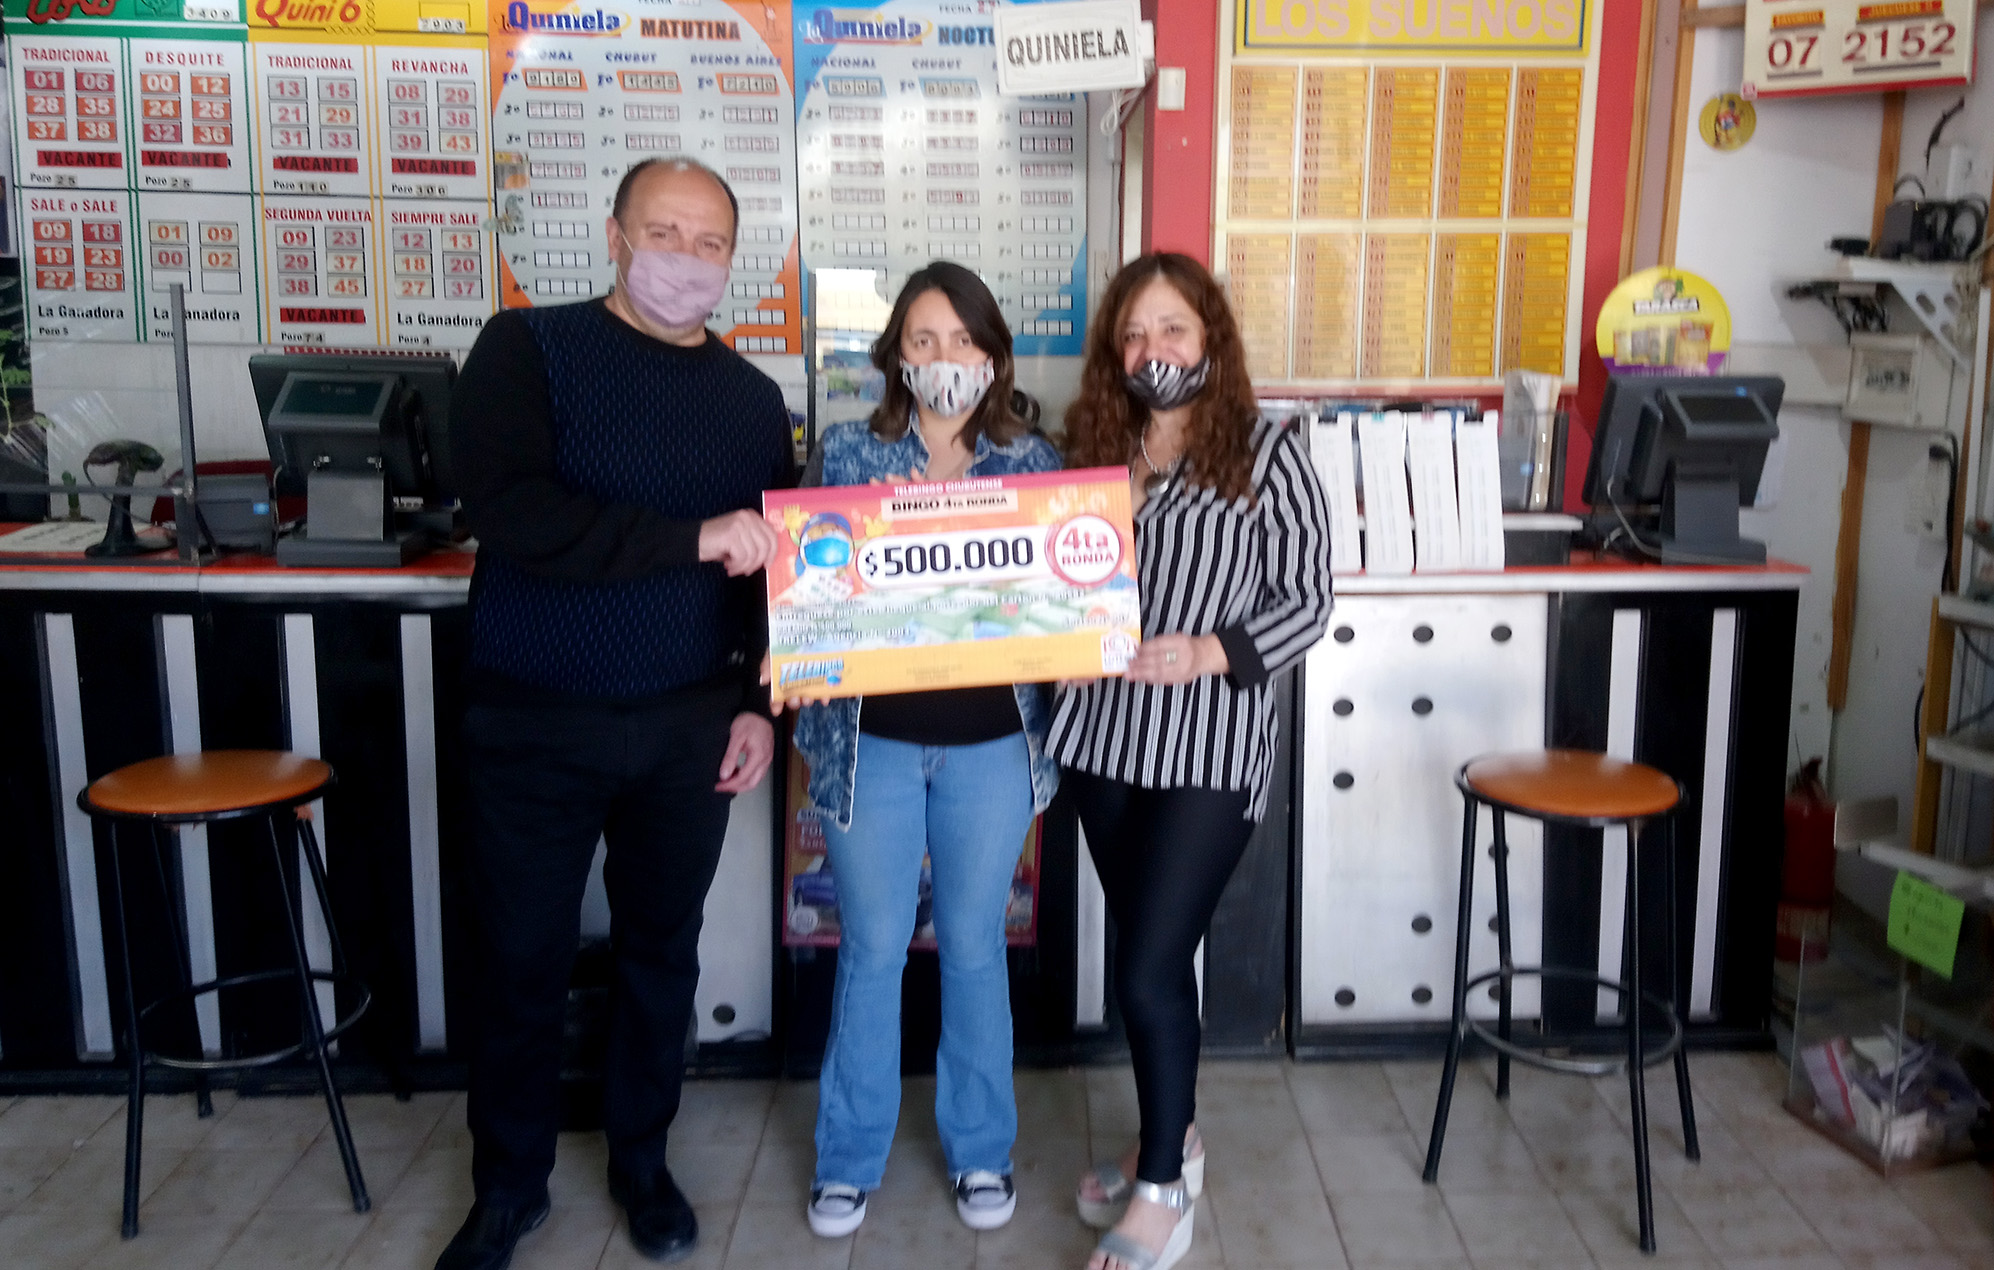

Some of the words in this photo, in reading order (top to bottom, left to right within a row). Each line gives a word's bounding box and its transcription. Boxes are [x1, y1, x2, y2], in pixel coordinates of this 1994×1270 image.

[255, 0, 336, 27] Quini
[339, 0, 361, 23] 6
[1255, 0, 1350, 38] LOS
[640, 18, 741, 40] MATUTINA
[1007, 27, 1130, 68] QUINIELA
[1768, 35, 1818, 67] 07
[1842, 23, 1955, 63] 2152
[22, 47, 111, 63] TRADICIONAL
[146, 52, 225, 66] DESQUITE
[268, 56, 353, 70] TRADICIONAL
[392, 60, 469, 74] REVANCHA
[33, 72, 58, 88] 01
[82, 73, 109, 90] 06
[146, 75, 173, 91] 00
[198, 78, 224, 93] 12
[276, 81, 300, 97] 13
[326, 82, 350, 98] 15
[395, 84, 421, 99] 08
[444, 87, 470, 103] 29
[33, 97, 60, 113] 28
[84, 97, 110, 114] 35
[149, 100, 175, 116] 24
[199, 102, 225, 118] 25
[278, 107, 301, 122] 21
[326, 109, 351, 123] 29
[398, 111, 421, 126] 31
[446, 112, 471, 127] 38
[34, 121, 60, 138] 37
[84, 121, 111, 138] 38
[149, 125, 175, 140] 32
[199, 127, 226, 143] 36
[280, 131, 302, 146] 31
[328, 134, 353, 149] 33
[397, 135, 422, 151] 39
[446, 135, 472, 151] 43
[43, 152, 117, 166] VACANTE
[149, 153, 221, 167] VACANTE
[279, 157, 351, 171] VACANTE
[400, 159, 469, 173] VACANTE
[30, 173, 52, 183] Pozo
[145, 176, 167, 186] Pozo
[273, 181, 295, 190] Pozo
[391, 185, 413, 193] Pozo
[31, 198, 65, 212] SALE
[83, 200, 118, 213] SALE
[265, 208, 322, 221] SEGUNDA
[327, 209, 371, 222] VUELTA
[392, 212, 446, 225] SIEMPRE
[450, 213, 479, 225] SALE
[40, 224, 66, 239] 09
[89, 225, 115, 240] 18
[157, 225, 181, 239] 01
[207, 227, 233, 242] 09
[282, 231, 308, 245] 09
[332, 231, 357, 245] 23
[400, 233, 424, 247] 12
[450, 234, 472, 248] 13
[43, 249, 67, 265] 19
[91, 249, 117, 266] 23
[158, 251, 183, 266] 00
[208, 253, 233, 267] 02
[284, 255, 309, 270] 29
[334, 255, 358, 270] 37
[401, 257, 425, 271] 18
[451, 258, 475, 272] 20
[43, 273, 69, 289] 27
[92, 274, 118, 289] 28
[285, 279, 310, 294] 38
[334, 279, 359, 294] 45
[402, 281, 425, 295] 27
[452, 281, 475, 295] 37
[38, 305, 54, 318] La
[59, 304, 124, 320] Ganadora
[153, 307, 169, 320] La
[183, 306, 240, 321] anadora
[286, 309, 358, 322] VACANTE
[397, 312, 414, 325] La
[418, 311, 483, 327] Ganadora
[281, 332, 302, 341] Pozo
[892, 499, 940, 512] BINGO
[1062, 527, 1109, 549] 4ta
[865, 551, 879, 578] $
[884, 537, 1034, 577] 500.000
[1062, 553, 1115, 566] RONDA
